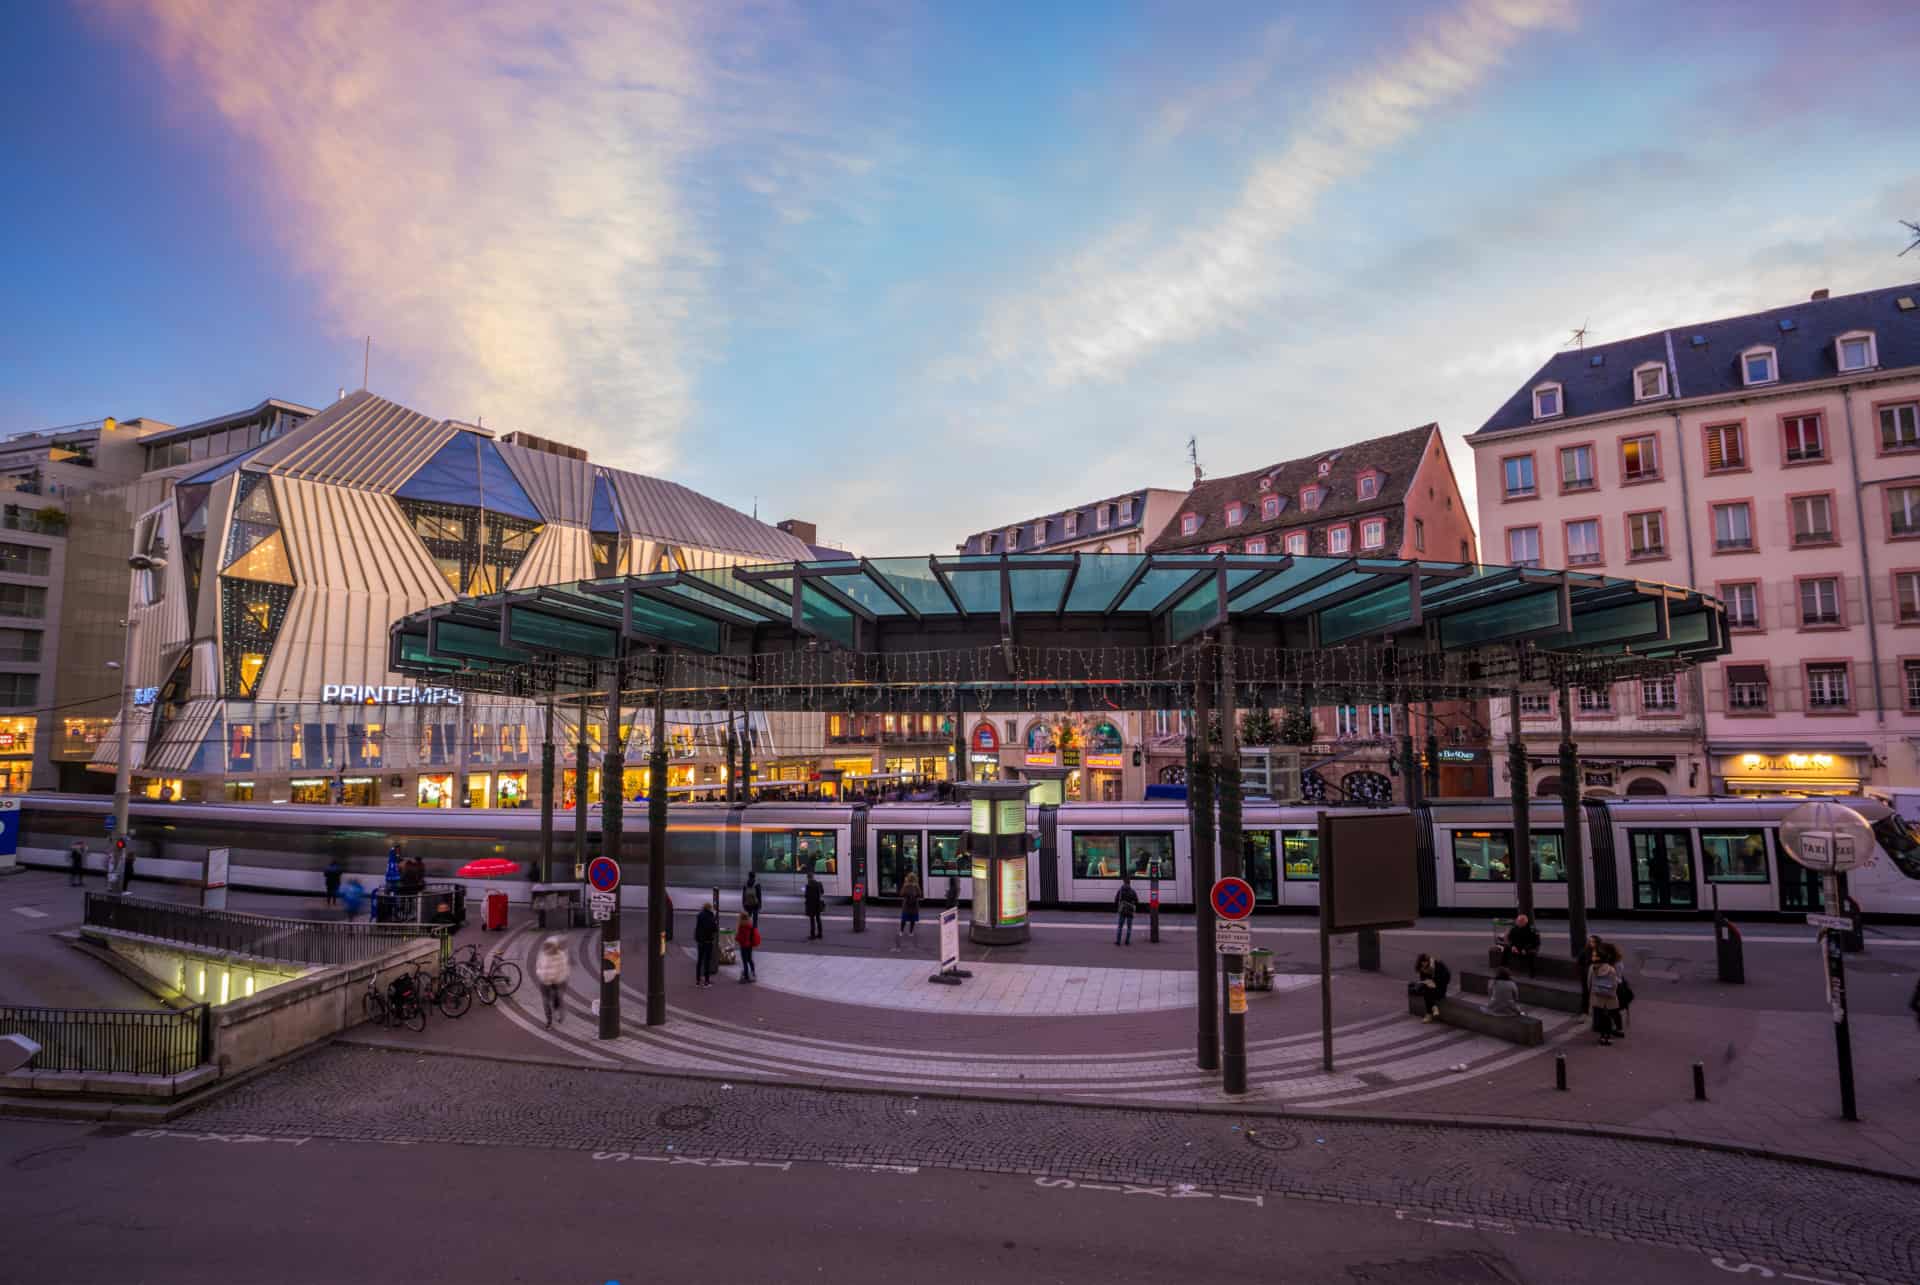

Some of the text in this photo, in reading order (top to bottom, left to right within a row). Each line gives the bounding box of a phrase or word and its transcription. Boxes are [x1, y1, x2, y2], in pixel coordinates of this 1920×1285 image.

[322, 684, 463, 703] PRINTEMPS
[591, 1151, 793, 1171] TAXIS
[1034, 1176, 1264, 1208] TAXIS
